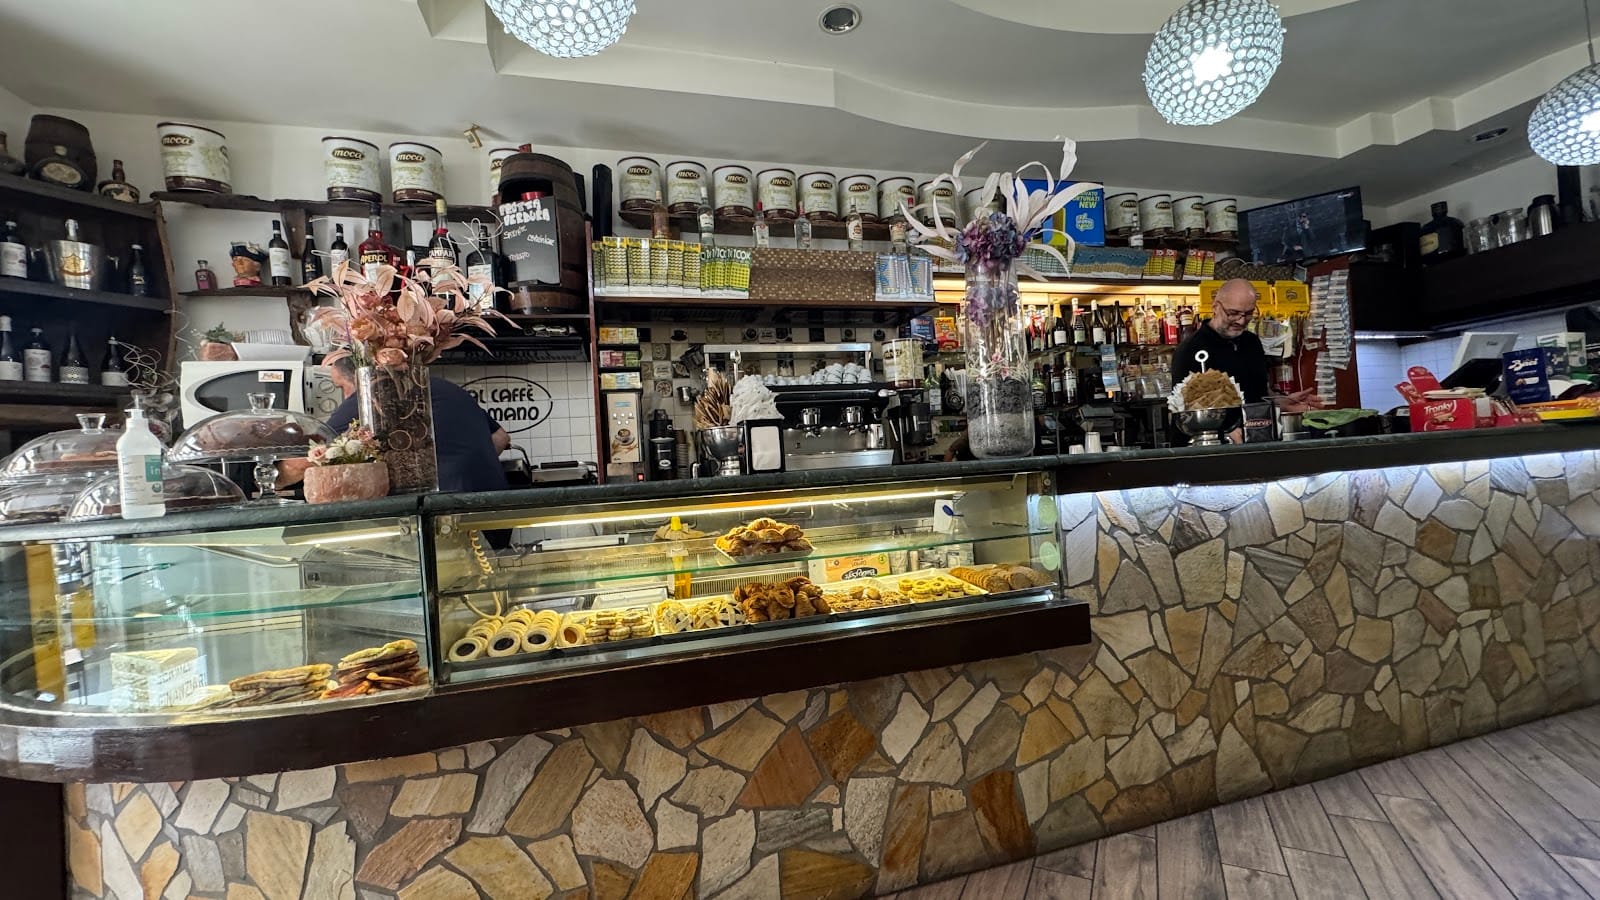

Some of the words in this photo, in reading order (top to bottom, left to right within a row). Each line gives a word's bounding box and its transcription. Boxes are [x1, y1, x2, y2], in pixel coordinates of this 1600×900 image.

[162, 136, 191, 145] moca
[333, 149, 363, 159] moca
[397, 153, 425, 162] moca
[627, 166, 651, 175] moca
[677, 170, 700, 179] moca
[727, 174, 748, 183] moca
[771, 178, 792, 186] moca
[812, 181, 833, 189] moca
[1079, 201, 1097, 209] NEW
[504, 208, 550, 226] VERDURA
[361, 253, 388, 264] APEROL
[491, 384, 535, 402] CAFFÈ
[1424, 402, 1453, 415] Tronky
[487, 406, 539, 421] MANO
